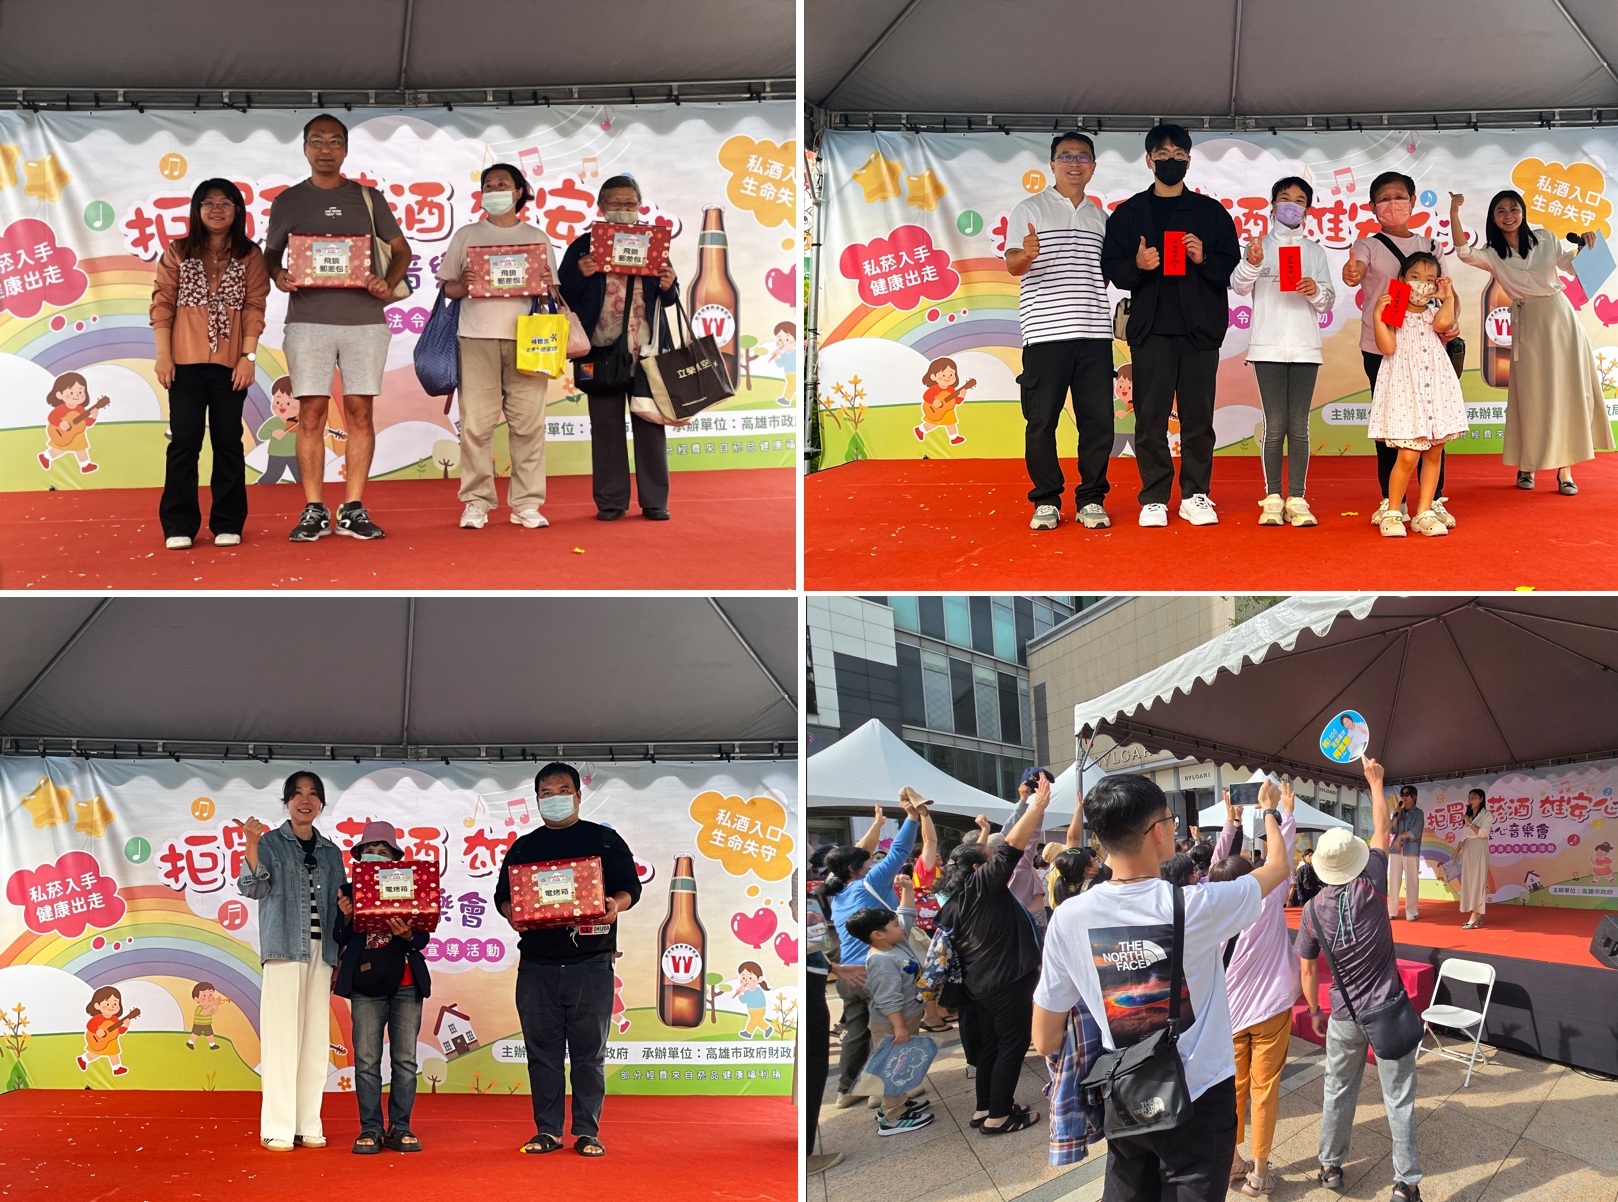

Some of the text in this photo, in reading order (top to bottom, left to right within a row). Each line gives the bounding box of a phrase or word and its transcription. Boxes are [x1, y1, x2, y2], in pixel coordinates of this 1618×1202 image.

[1537, 175, 1601, 207] 私酒入口
[1530, 194, 1596, 227] 生命失守
[862, 244, 931, 277] 私菸入手
[870, 265, 939, 297] 健康出走
[672, 415, 796, 434] 承辦單位：高雄市政
[1467, 407, 1507, 420] 承辦單
[1184, 772, 1211, 782] BVLGARI
[715, 809, 783, 842] 私酒入口
[1427, 796, 1530, 829] 拒買菸酒
[709, 828, 777, 862] 生命失守
[29, 872, 97, 903] 私菸入手
[36, 892, 106, 923] 健康出走
[426, 942, 500, 957] 宣導活動
[1102, 950, 1144, 963] NORTH
[1118, 940, 1143, 952] THE
[1116, 959, 1147, 971] FACE
